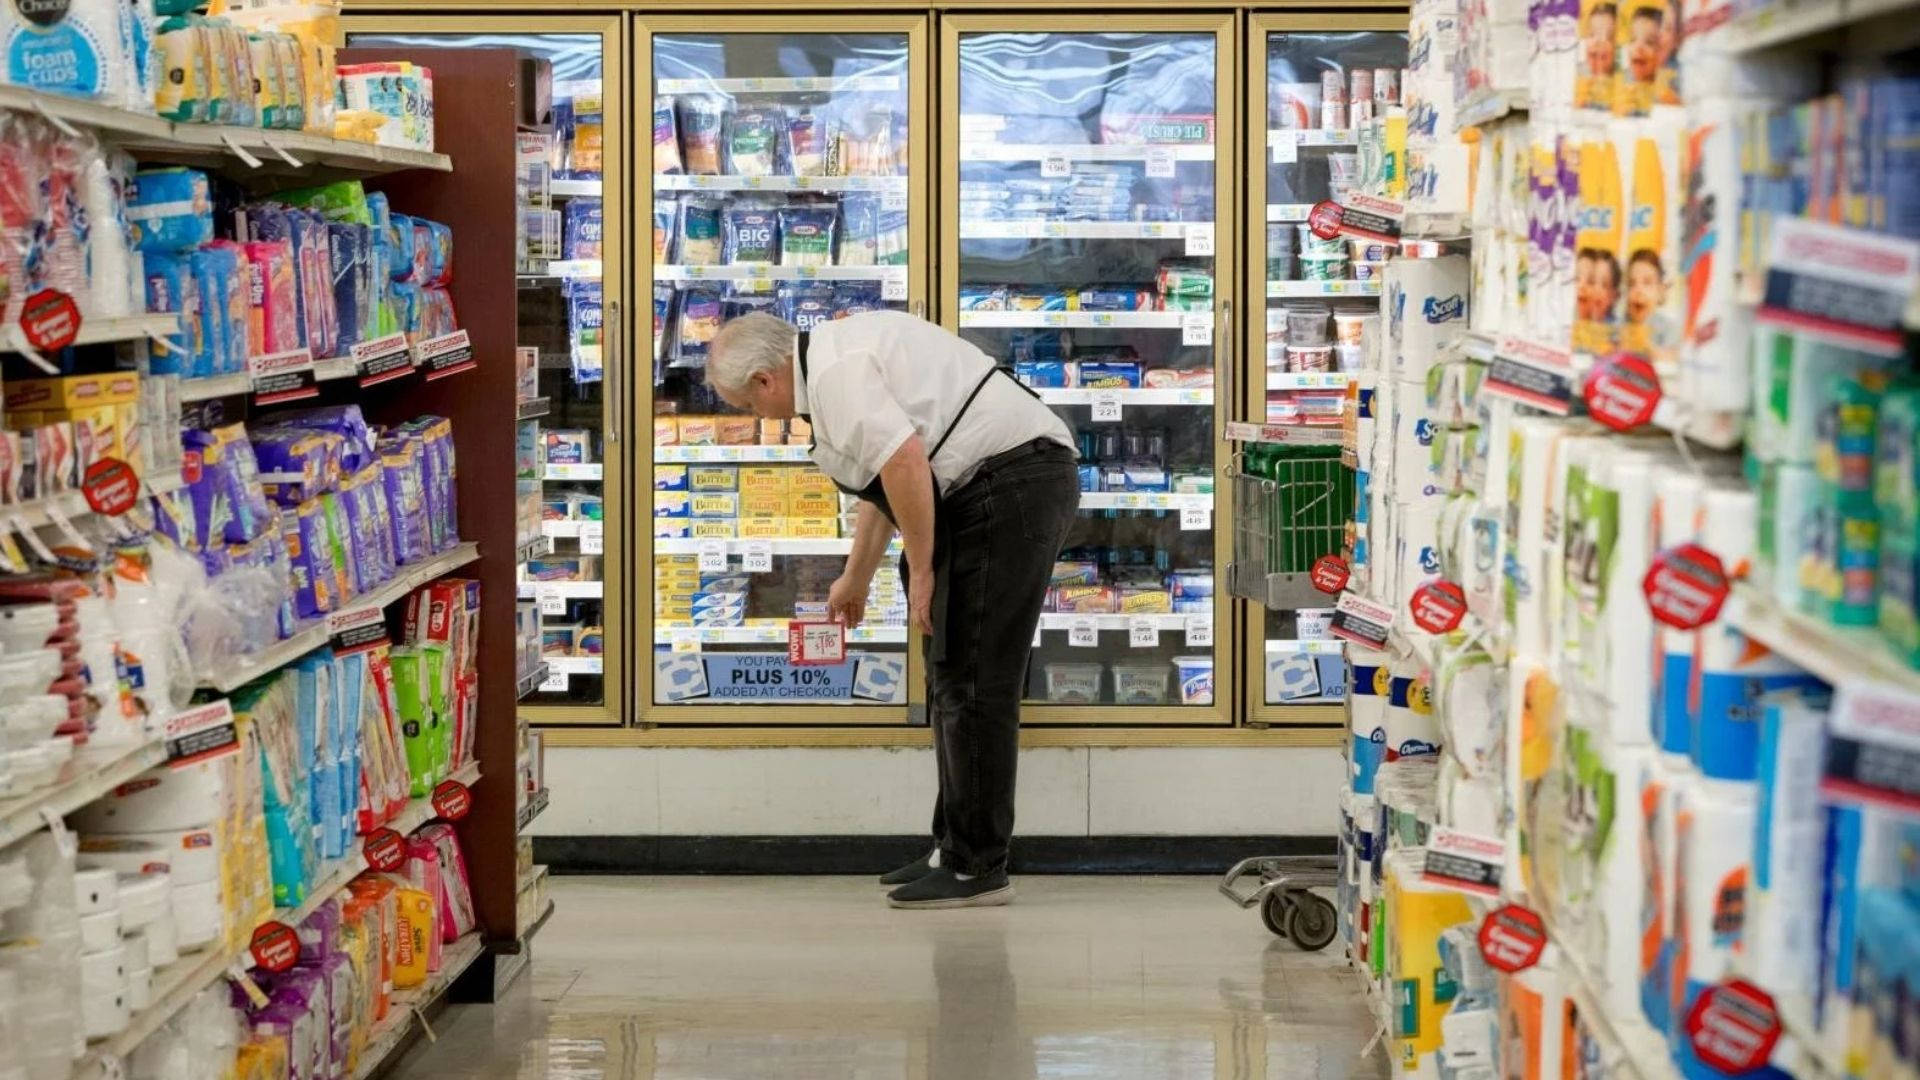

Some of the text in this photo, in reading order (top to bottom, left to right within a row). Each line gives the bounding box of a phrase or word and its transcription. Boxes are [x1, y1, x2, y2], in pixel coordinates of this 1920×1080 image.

[23, 49, 77, 71] foam
[28, 68, 78, 84] cups
[739, 229, 770, 242] BIG
[742, 241, 768, 249] SLICE
[796, 314, 826, 327] BIG
[696, 474, 731, 485] BUTTER
[746, 474, 781, 485] BUTTER
[795, 474, 830, 485] BUTTER
[696, 499, 731, 510] BUTTER
[795, 499, 830, 510] BUTTER
[696, 524, 731, 535] BUTTER
[746, 524, 780, 535] BUTTER
[795, 524, 830, 535] BUTTER
[790, 629, 800, 662] WOW!
[735, 656, 789, 667] YOU PAY
[732, 669, 831, 685] PLUS 10%
[714, 686, 849, 698] ADDED AT CHECKOUT
